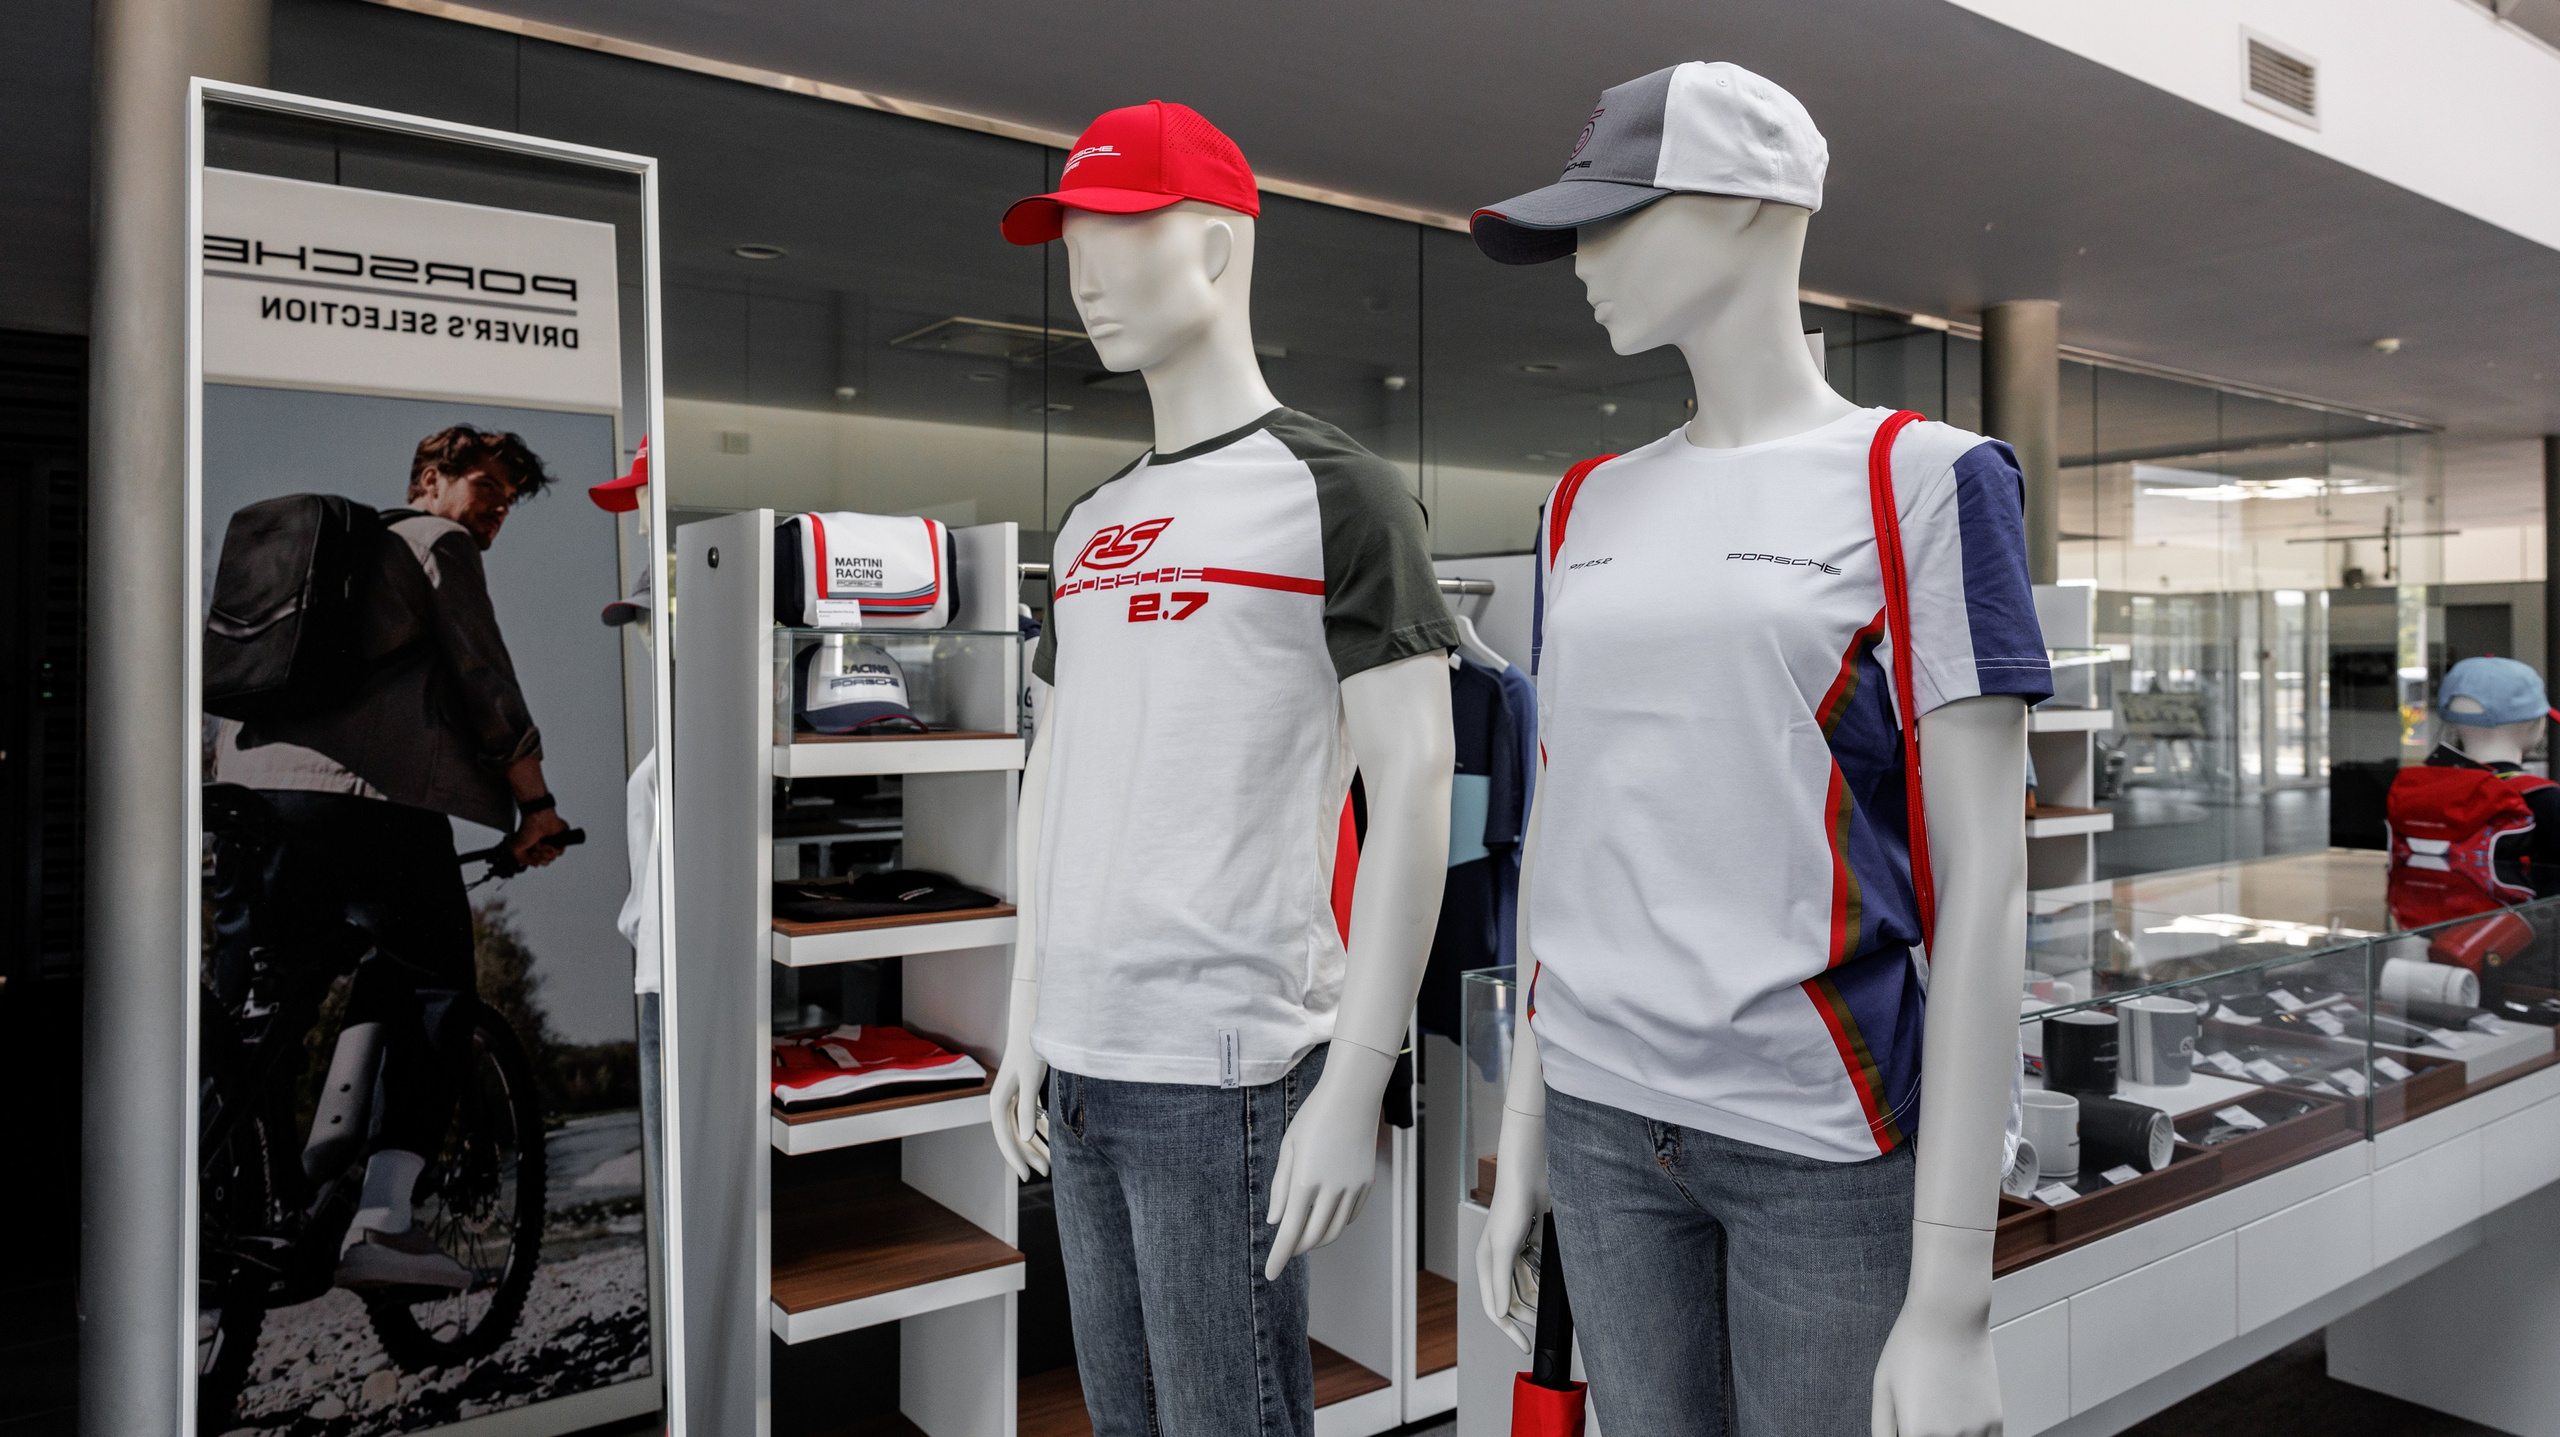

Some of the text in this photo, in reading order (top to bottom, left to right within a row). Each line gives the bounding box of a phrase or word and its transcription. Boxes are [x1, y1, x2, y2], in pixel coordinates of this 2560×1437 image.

[1066, 517, 1175, 579] RS
[835, 557, 883, 567] MARTINI
[836, 568, 883, 579] RACING
[1726, 553, 1842, 576] PORSCHE
[1128, 592, 1209, 623] 2.7
